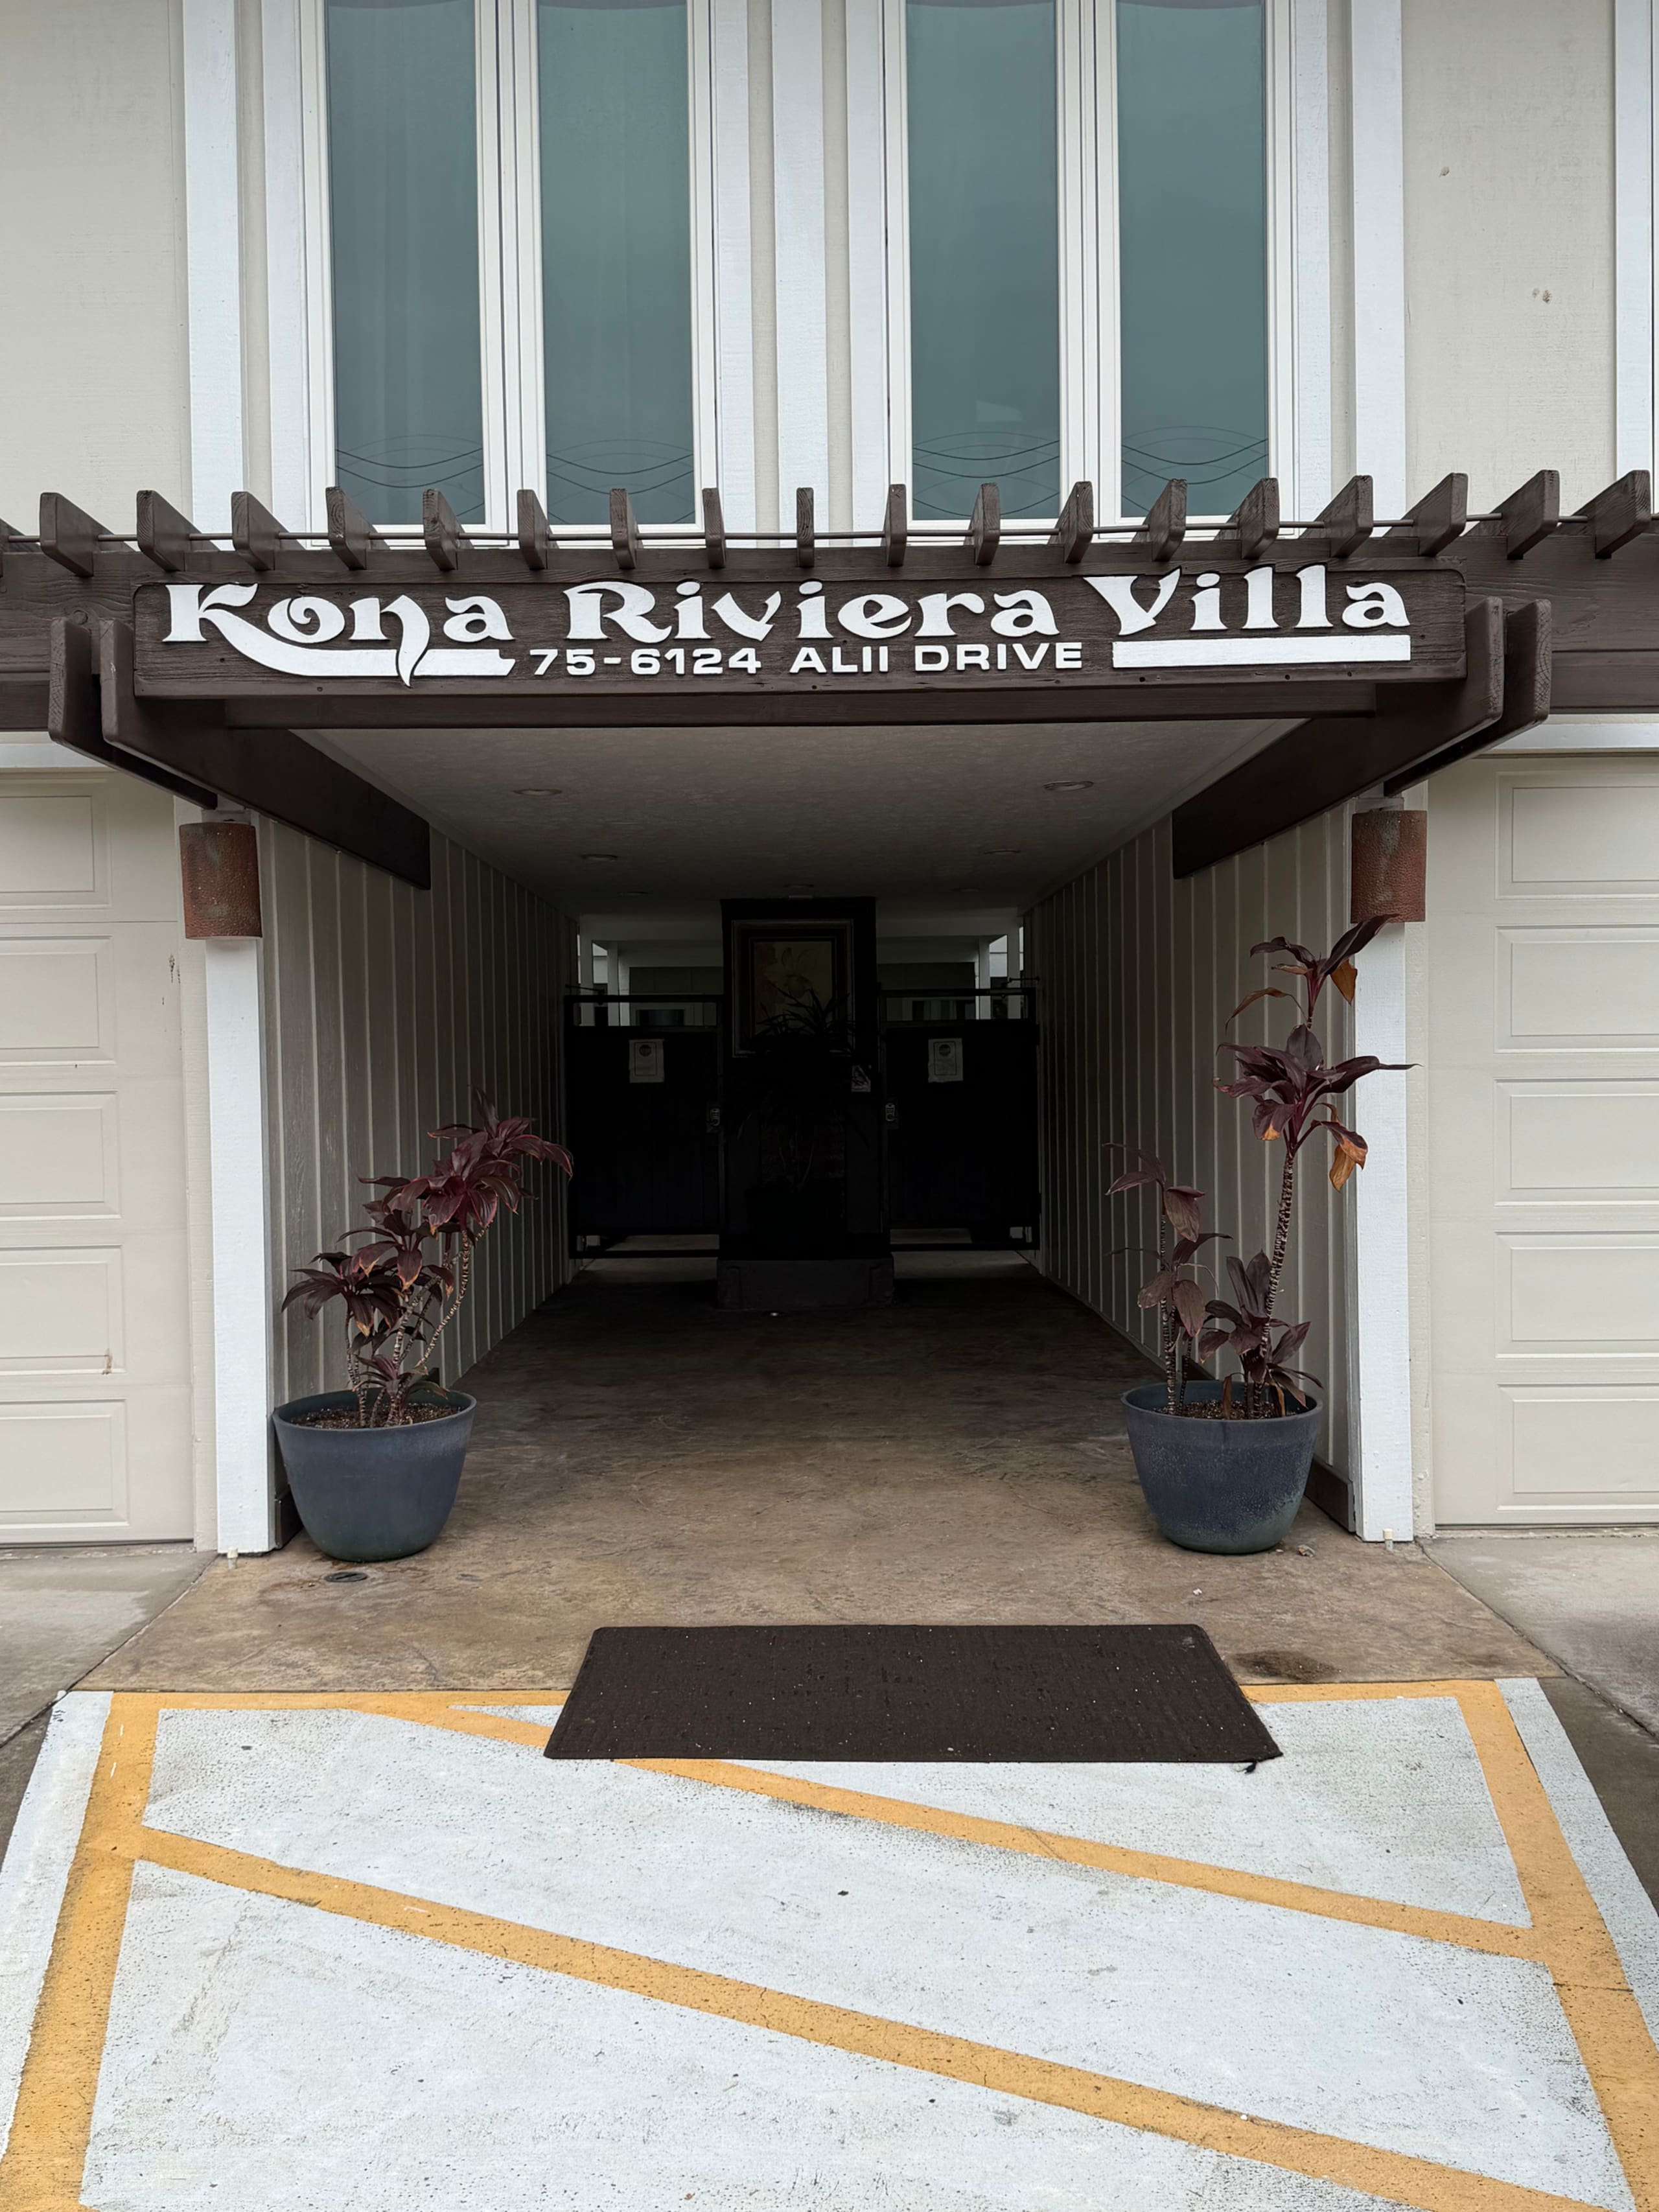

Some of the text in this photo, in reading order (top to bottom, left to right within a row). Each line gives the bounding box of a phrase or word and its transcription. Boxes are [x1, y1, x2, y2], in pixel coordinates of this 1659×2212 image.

[162, 565, 1411, 686] Kona Riviera Villa
[529, 642, 1083, 675] 75-6124 ALII DRIVE
